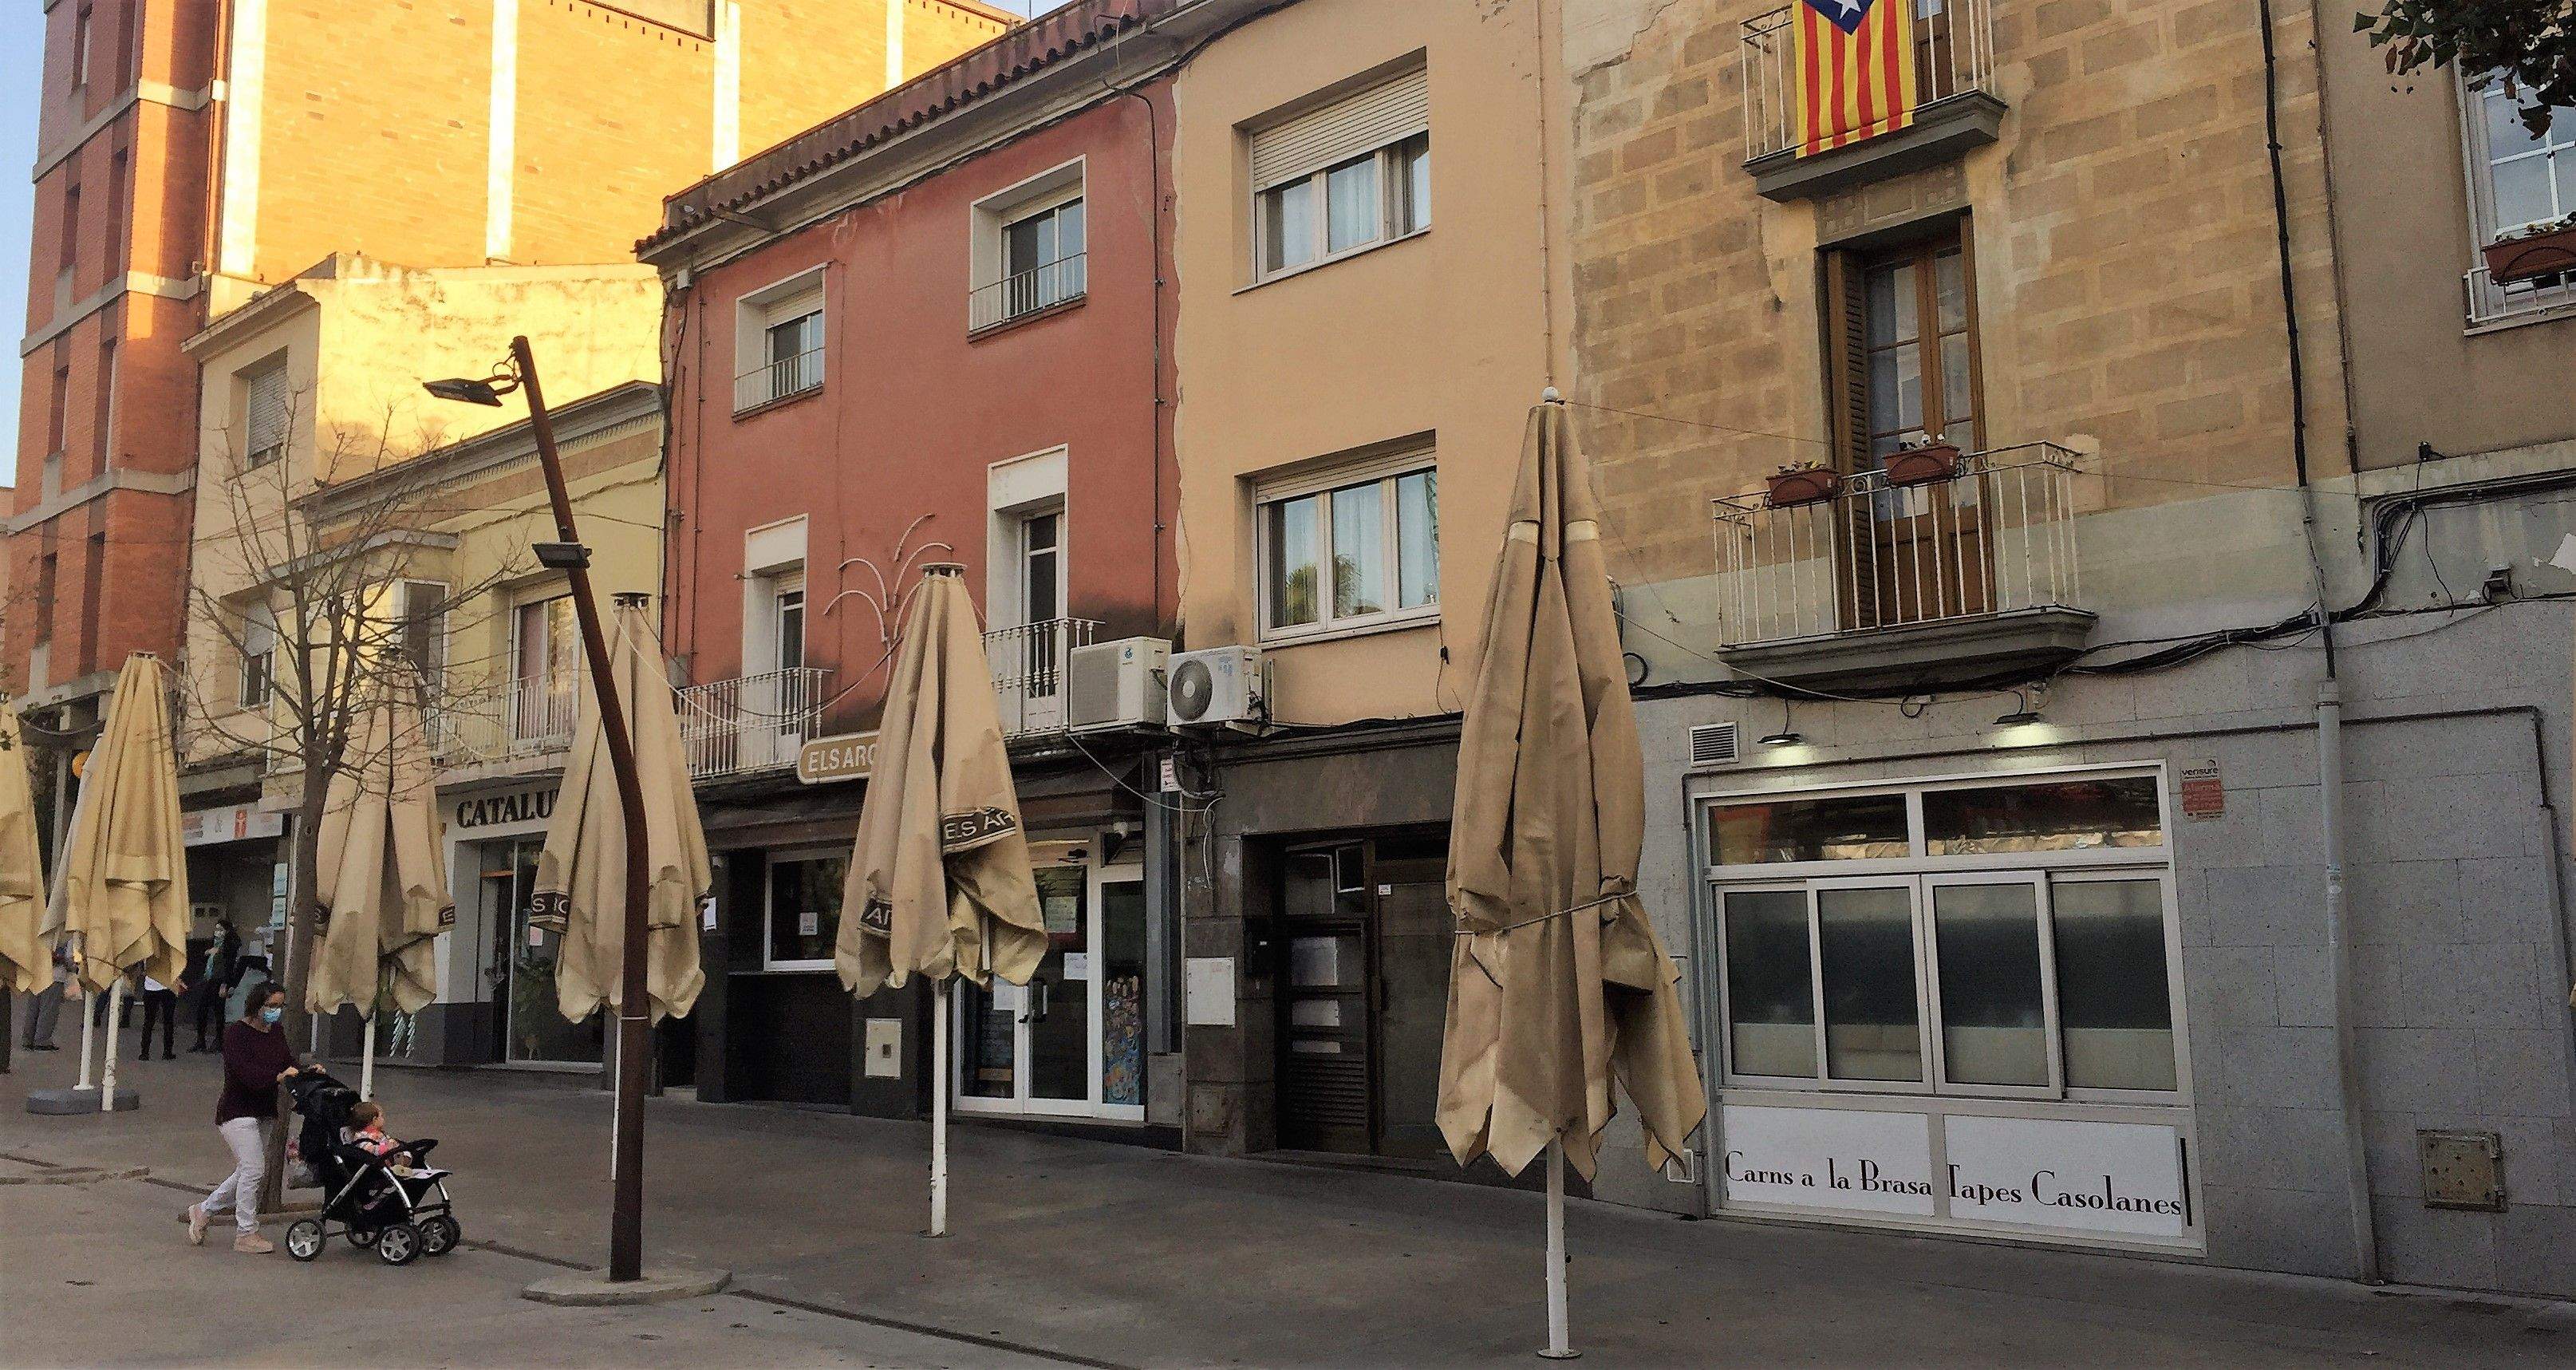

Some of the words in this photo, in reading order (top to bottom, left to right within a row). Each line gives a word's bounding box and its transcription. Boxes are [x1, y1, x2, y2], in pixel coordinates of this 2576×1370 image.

[456, 788, 559, 829] CATALU
[1725, 1151, 1793, 1185] Carns
[1801, 1173, 1816, 1187] a
[1826, 1157, 1852, 1190] la
[1858, 1159, 1933, 1196] Brasa
[1947, 1163, 2022, 1206] Tapes
[2031, 1170, 2182, 1215] Casolanes
